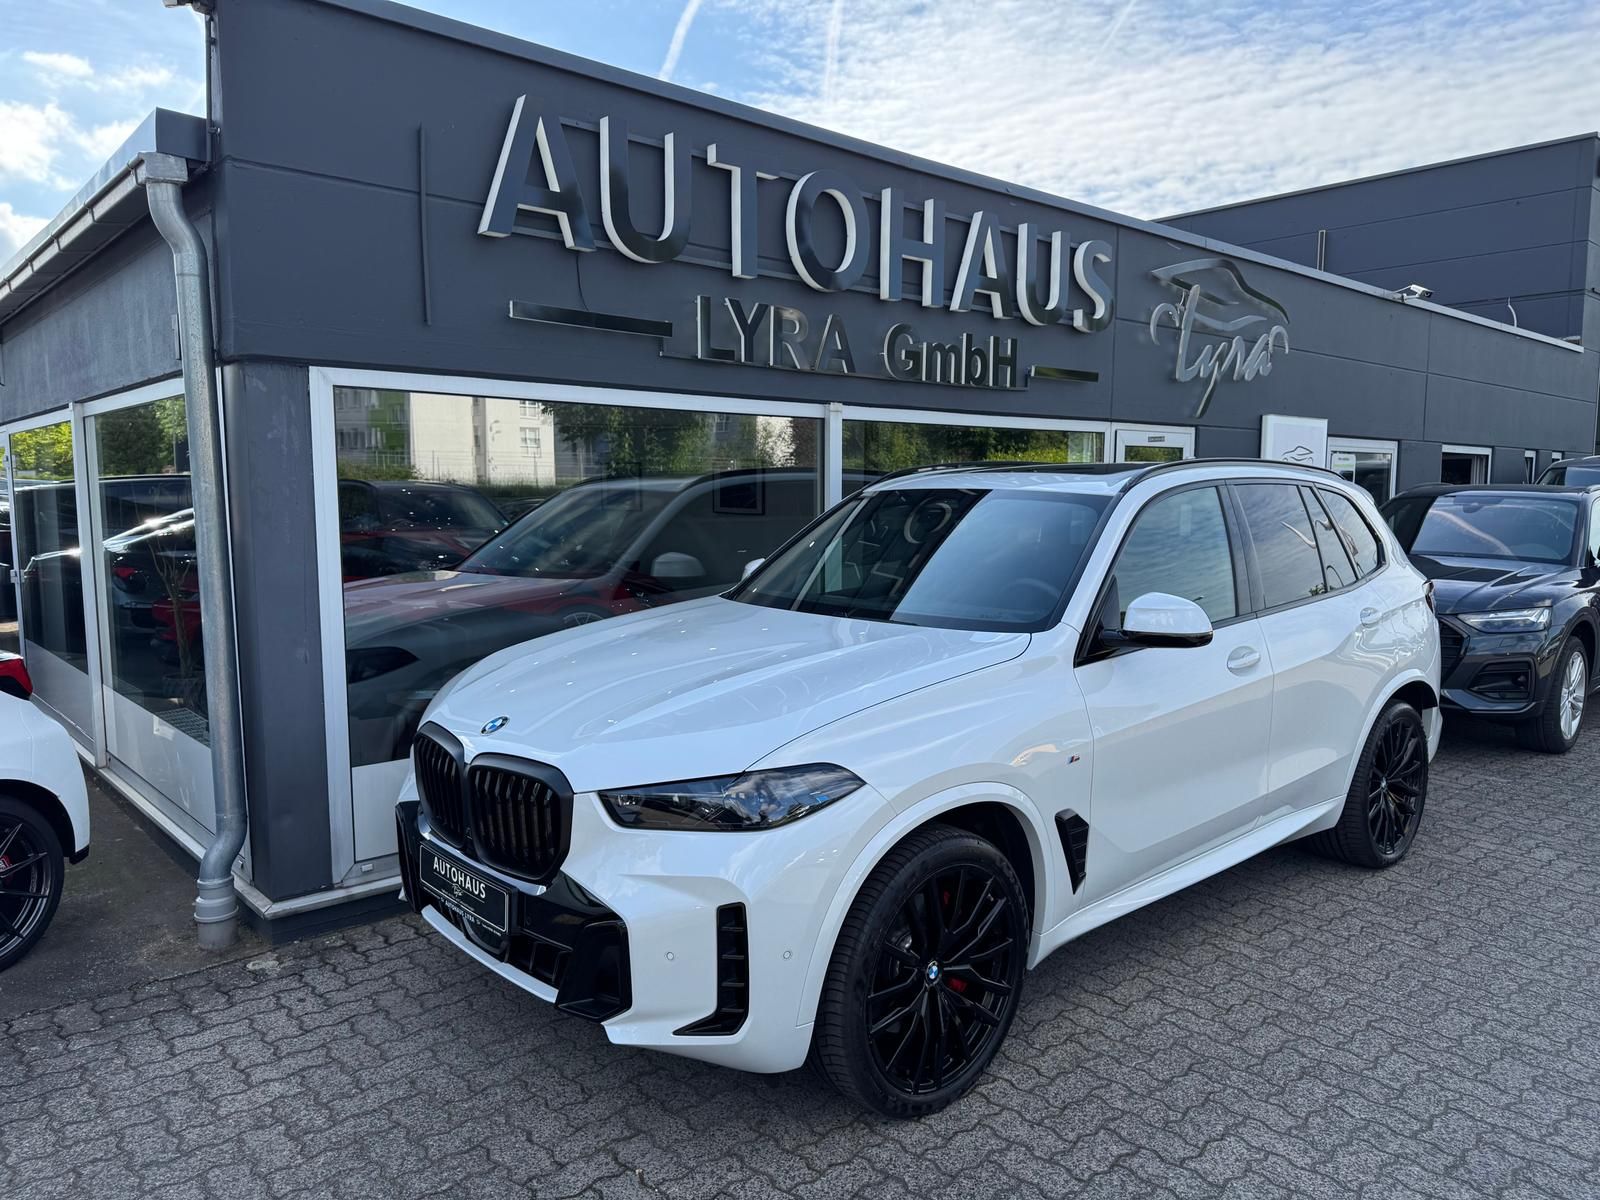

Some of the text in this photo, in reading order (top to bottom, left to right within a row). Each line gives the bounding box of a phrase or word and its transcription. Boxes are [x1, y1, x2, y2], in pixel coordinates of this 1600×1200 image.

[478, 94, 1113, 333] AUTOHAUS
[696, 295, 1018, 388] LYRA GmbH
[433, 856, 486, 899] AUTOHAUS
